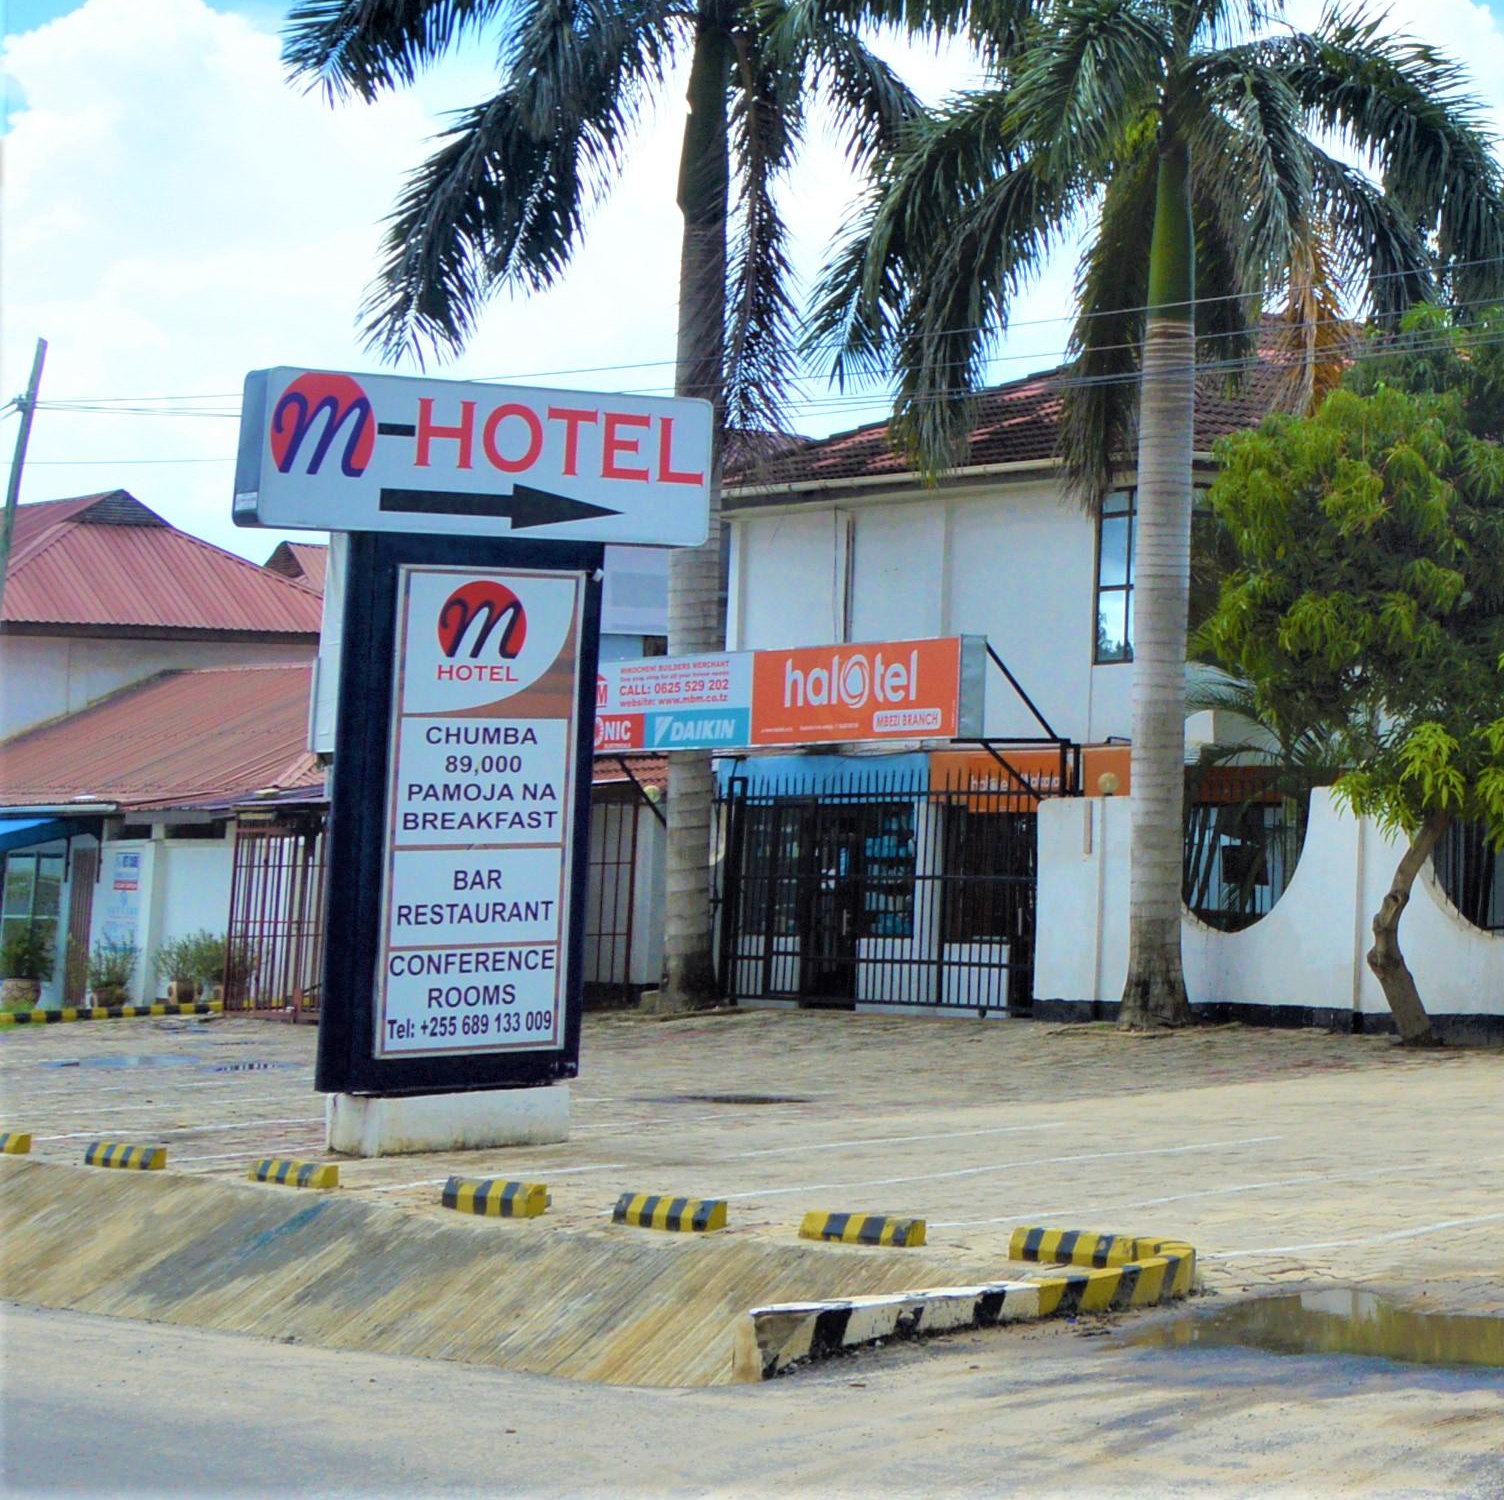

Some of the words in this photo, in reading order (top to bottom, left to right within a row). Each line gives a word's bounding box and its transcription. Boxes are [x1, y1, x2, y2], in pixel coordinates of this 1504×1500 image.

[437, 664, 518, 682] HOTEL
[659, 663, 691, 672] BUILDERS
[693, 660, 730, 669] MERCHANT
[620, 685, 651, 696] CALL:
[655, 683, 680, 694] 0625
[685, 681, 704, 692] 529
[709, 679, 729, 691] 202
[784, 650, 918, 708] halotel
[620, 698, 655, 708] website:
[876, 714, 900, 727] MBEZI
[902, 713, 939, 726] BRANCH
[425, 726, 538, 746] CHUMBA
[670, 720, 736, 741] DAIKIN
[445, 756, 522, 778] 89,000
[408, 783, 514, 802] PAMOJA
[522, 783, 556, 801] NA
[403, 811, 558, 831] BREAKFAST
[453, 869, 502, 891] BAR
[397, 900, 554, 926] RESTAURANT
[389, 949, 555, 977] CONFERENCE
[427, 984, 516, 1009] ROOMS
[387, 1019, 415, 1041] Tel:
[420, 1016, 457, 1038] +255
[462, 1014, 489, 1035] 689
[495, 1012, 520, 1033] 133
[525, 1010, 552, 1031] 009
